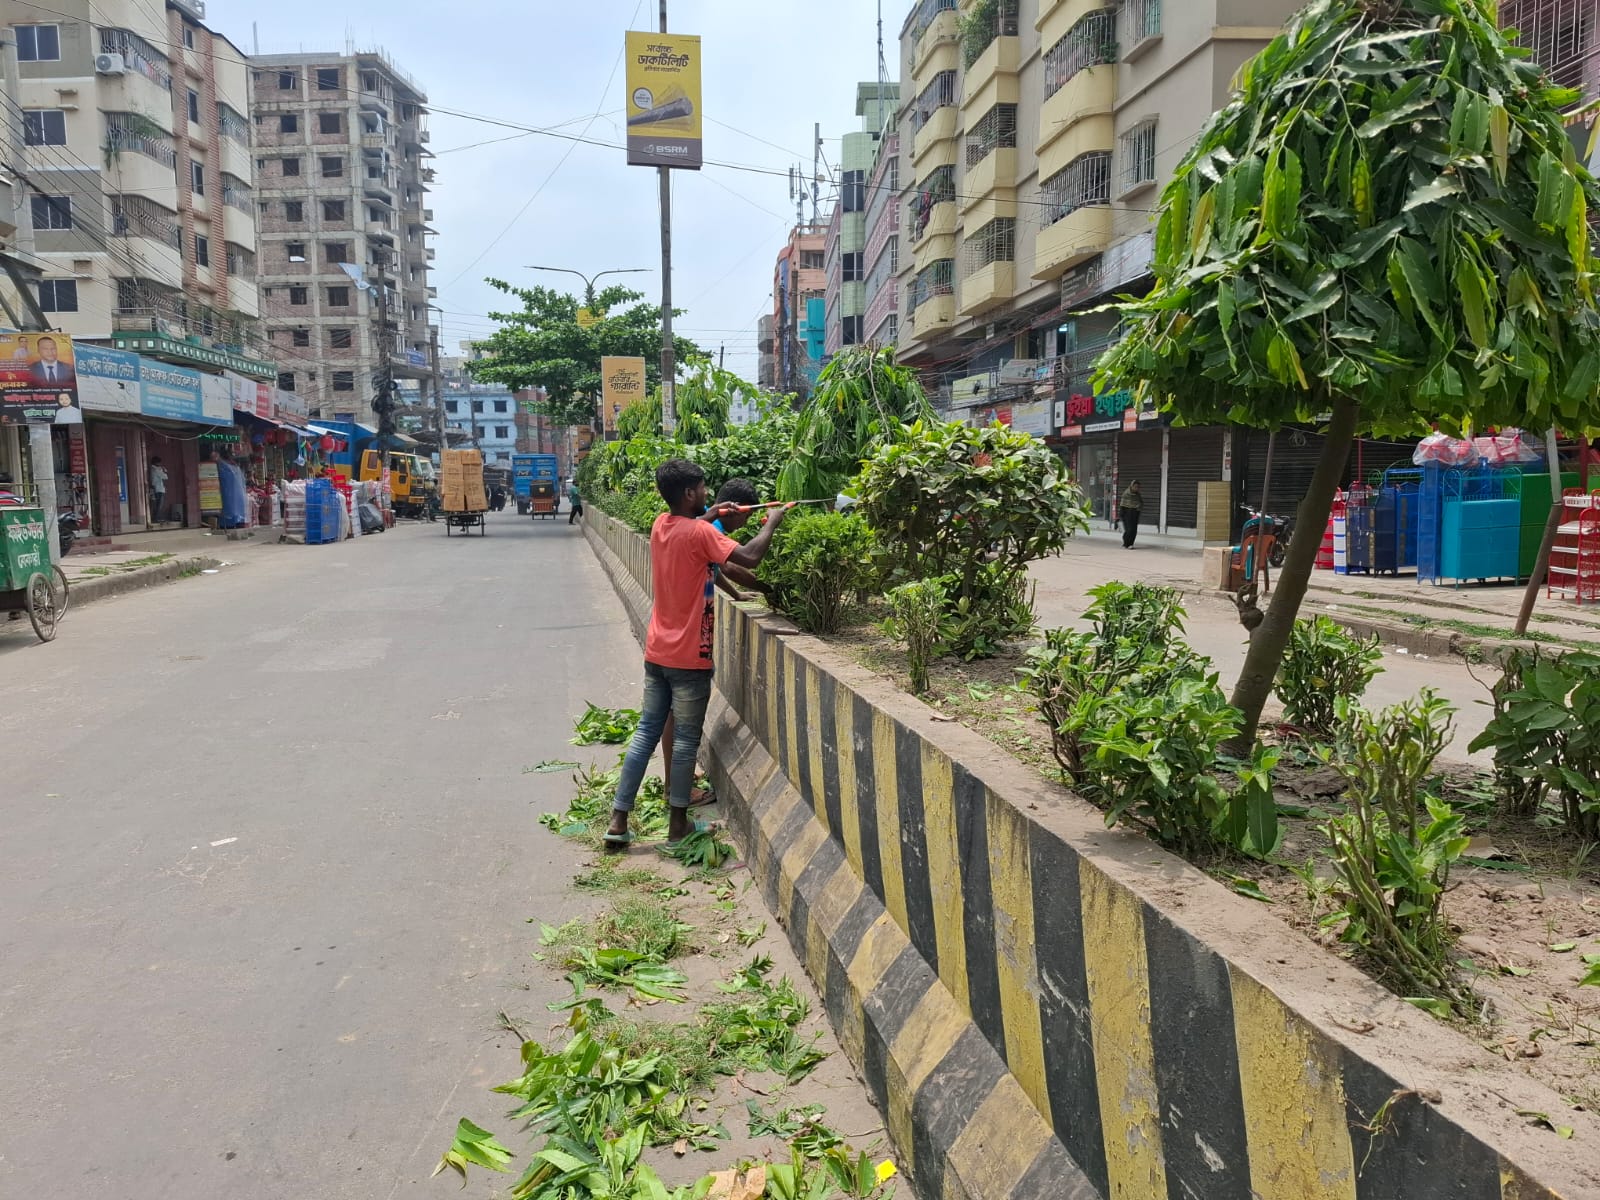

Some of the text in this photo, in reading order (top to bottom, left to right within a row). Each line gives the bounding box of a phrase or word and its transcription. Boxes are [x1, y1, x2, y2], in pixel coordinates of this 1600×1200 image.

[646, 43, 673, 53] সর্বোচ্চ
[637, 53, 690, 67] ডাকটিলিটি
[656, 145, 688, 153] BSRM
